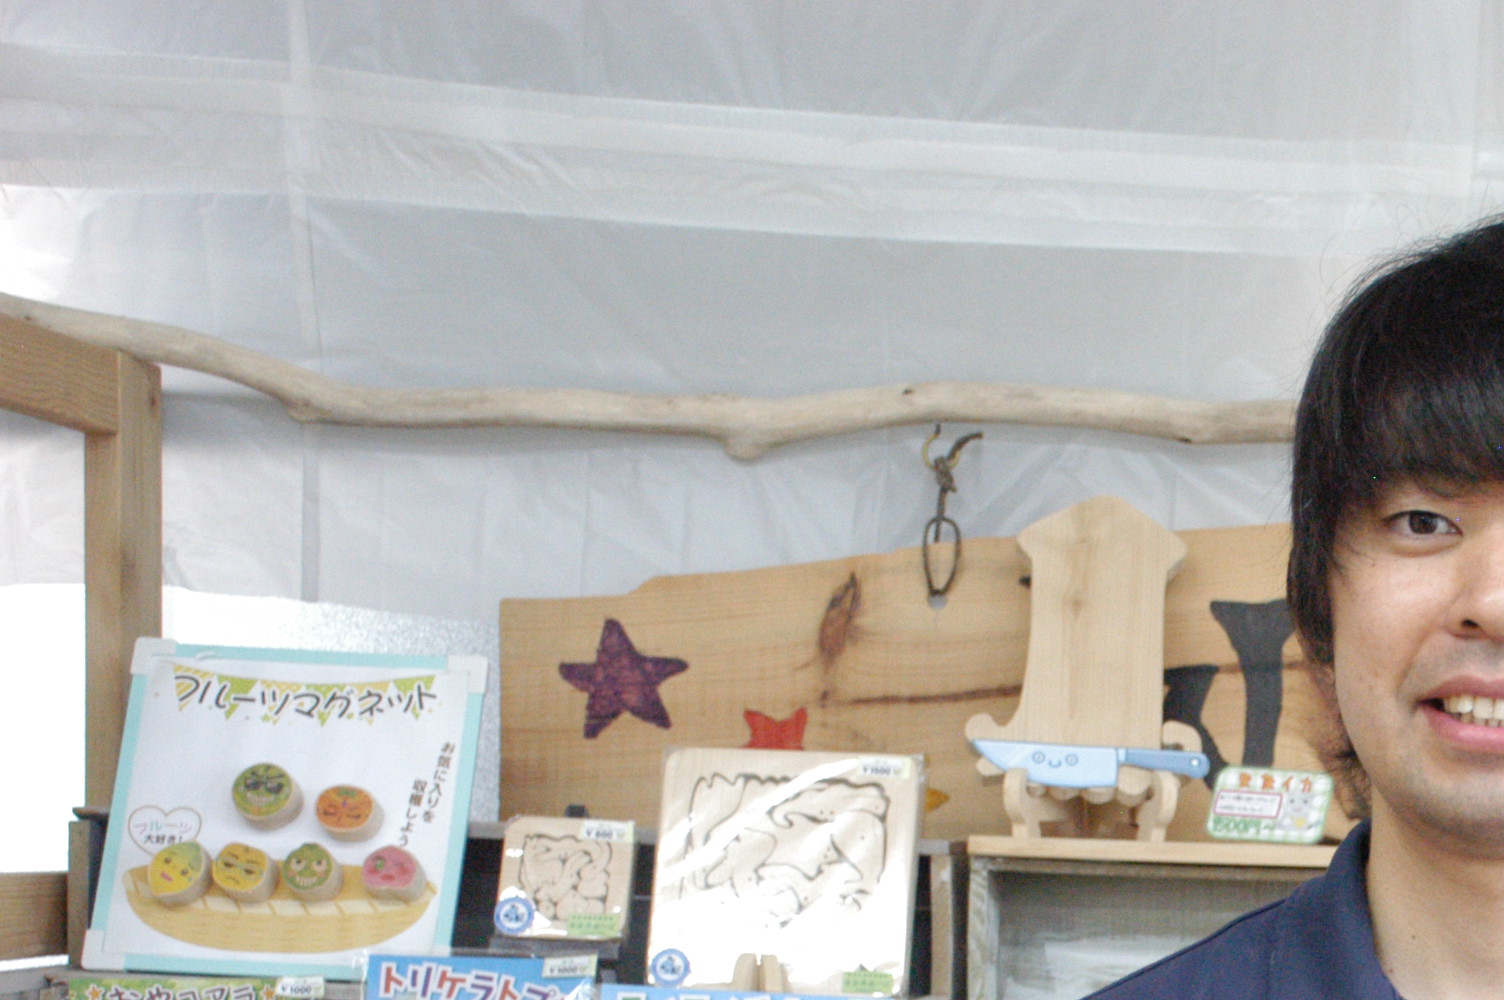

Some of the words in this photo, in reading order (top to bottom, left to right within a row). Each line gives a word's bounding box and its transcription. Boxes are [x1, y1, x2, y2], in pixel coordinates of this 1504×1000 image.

[173, 673, 437, 718] フルーツマグネット
